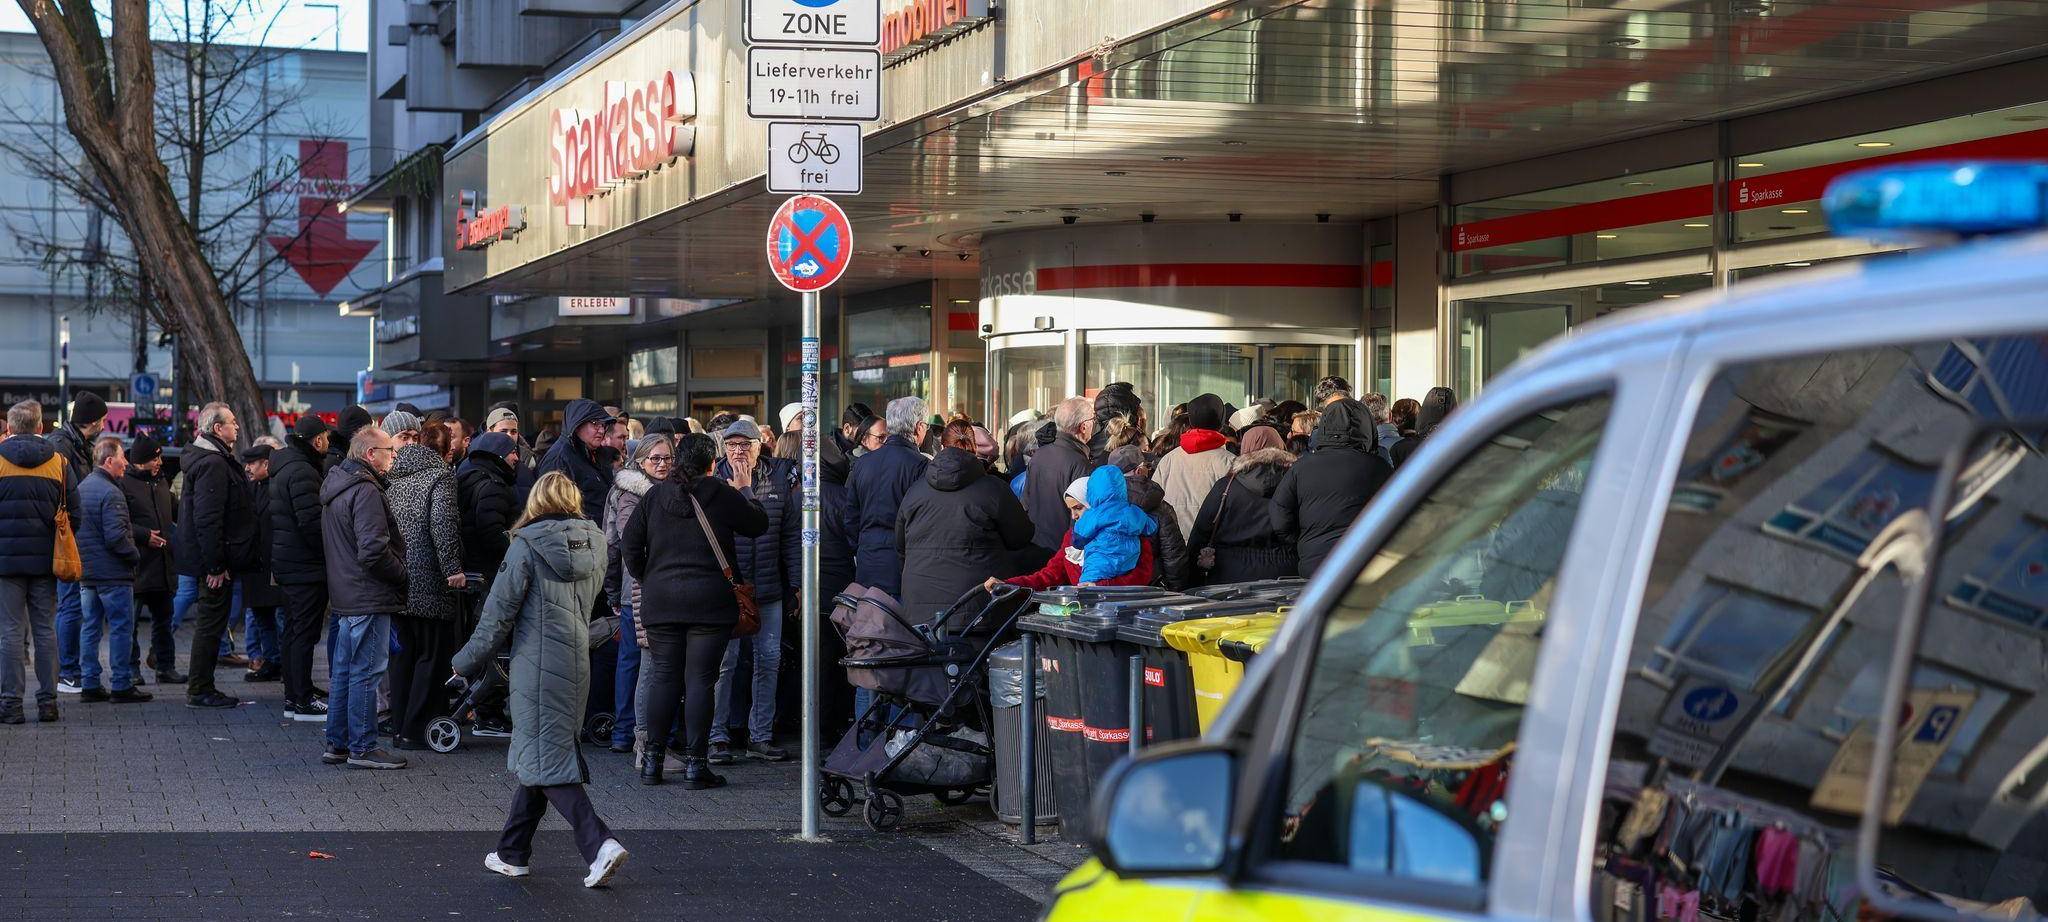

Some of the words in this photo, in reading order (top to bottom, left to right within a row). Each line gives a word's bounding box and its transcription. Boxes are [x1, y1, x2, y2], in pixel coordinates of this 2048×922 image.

[782, 13, 847, 35] ZONE
[880, 0, 967, 54] mobilien
[756, 62, 873, 80] Lieferverkehr
[769, 88, 820, 104] 19-11h
[830, 90, 859, 105] frei
[551, 70, 690, 226] Sparkasse
[800, 169, 828, 184] frei
[1751, 187, 1783, 203] Sparkasse
[1466, 231, 1490, 246] Sparkasse
[571, 298, 616, 308] ERLEBEN
[1144, 669, 1161, 683] SULO
[1058, 719, 1085, 730] Sparkass
[1098, 729, 1130, 741] Sparkass
